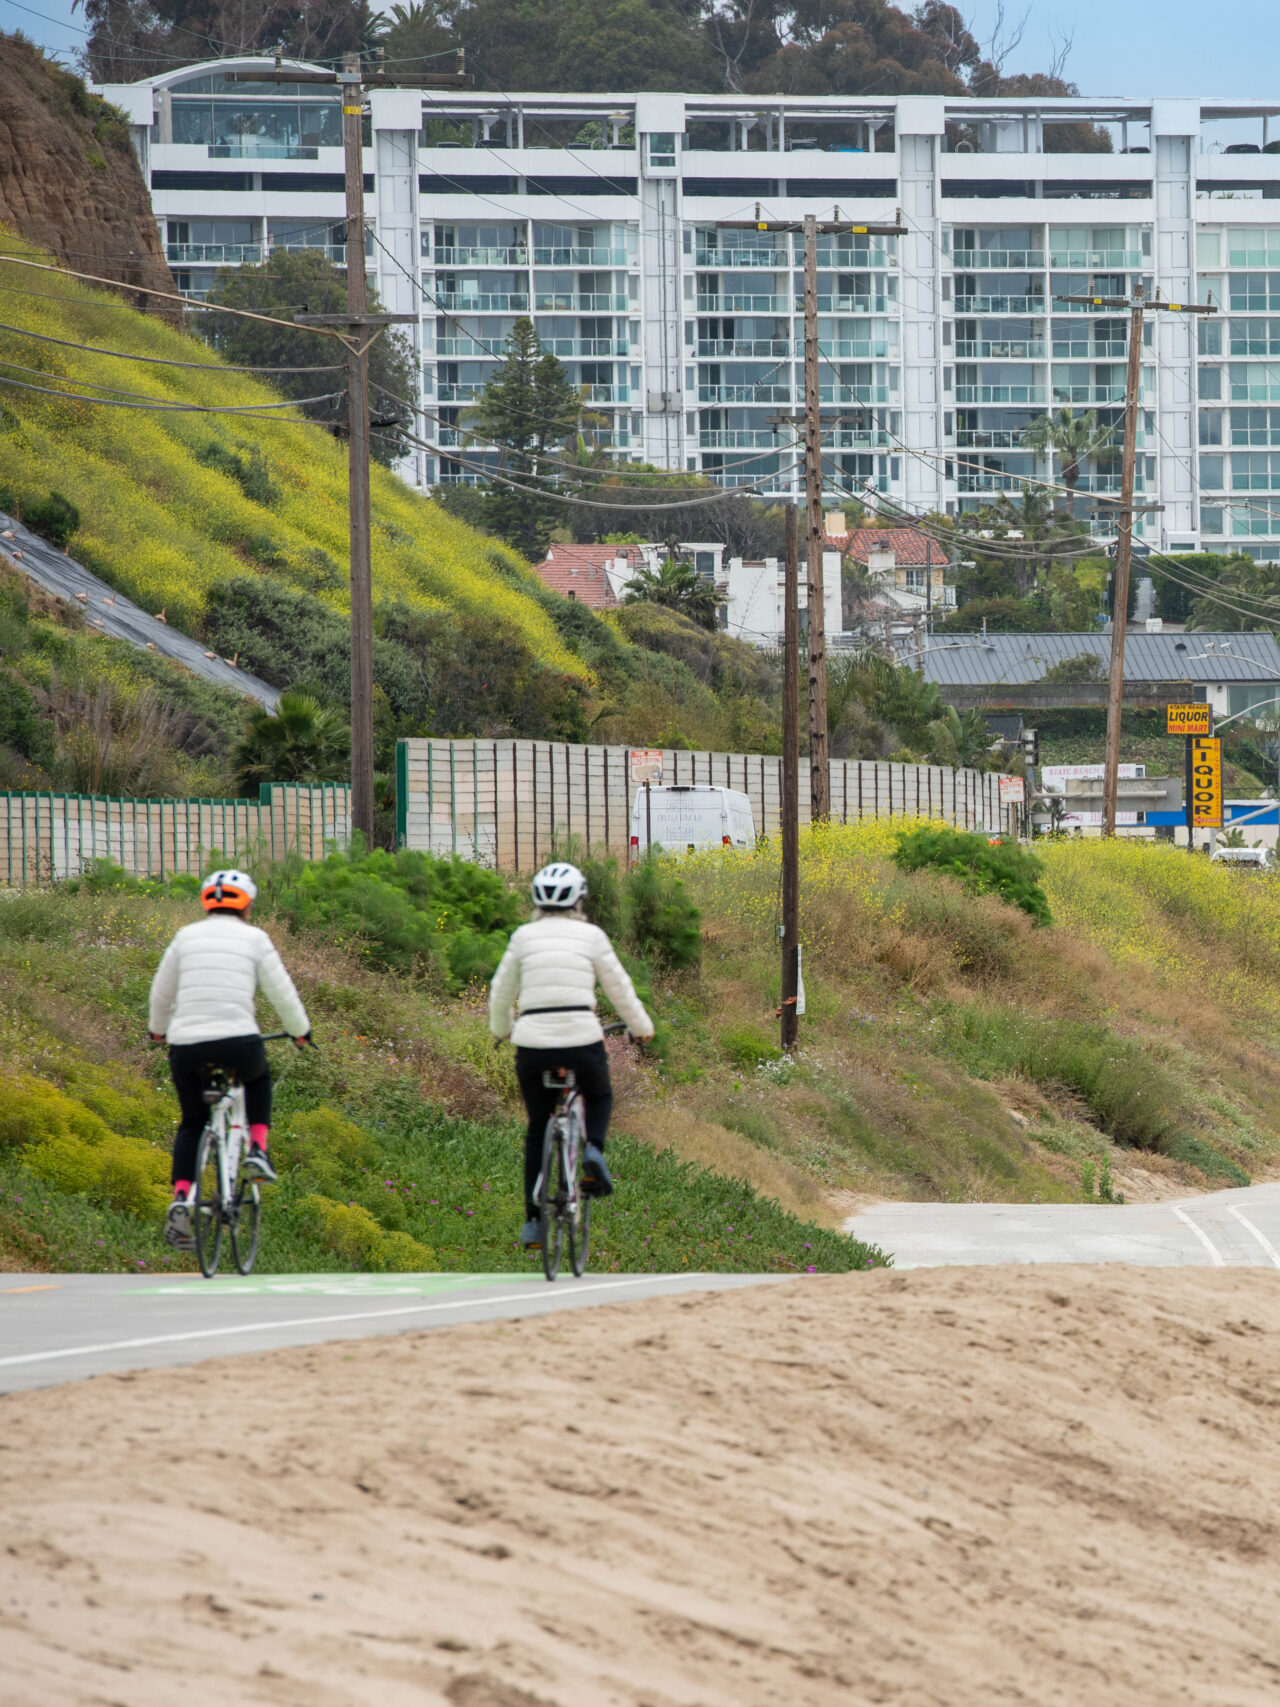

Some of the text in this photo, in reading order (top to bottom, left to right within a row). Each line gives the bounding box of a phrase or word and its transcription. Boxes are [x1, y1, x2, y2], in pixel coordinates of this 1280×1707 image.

[1169, 711, 1208, 724] LIQUOR
[1169, 724, 1208, 733] MINI MART
[1049, 768, 1072, 776] STATE
[1073, 766, 1099, 775] BEACH
[1194, 739, 1214, 815] LIQUOR
